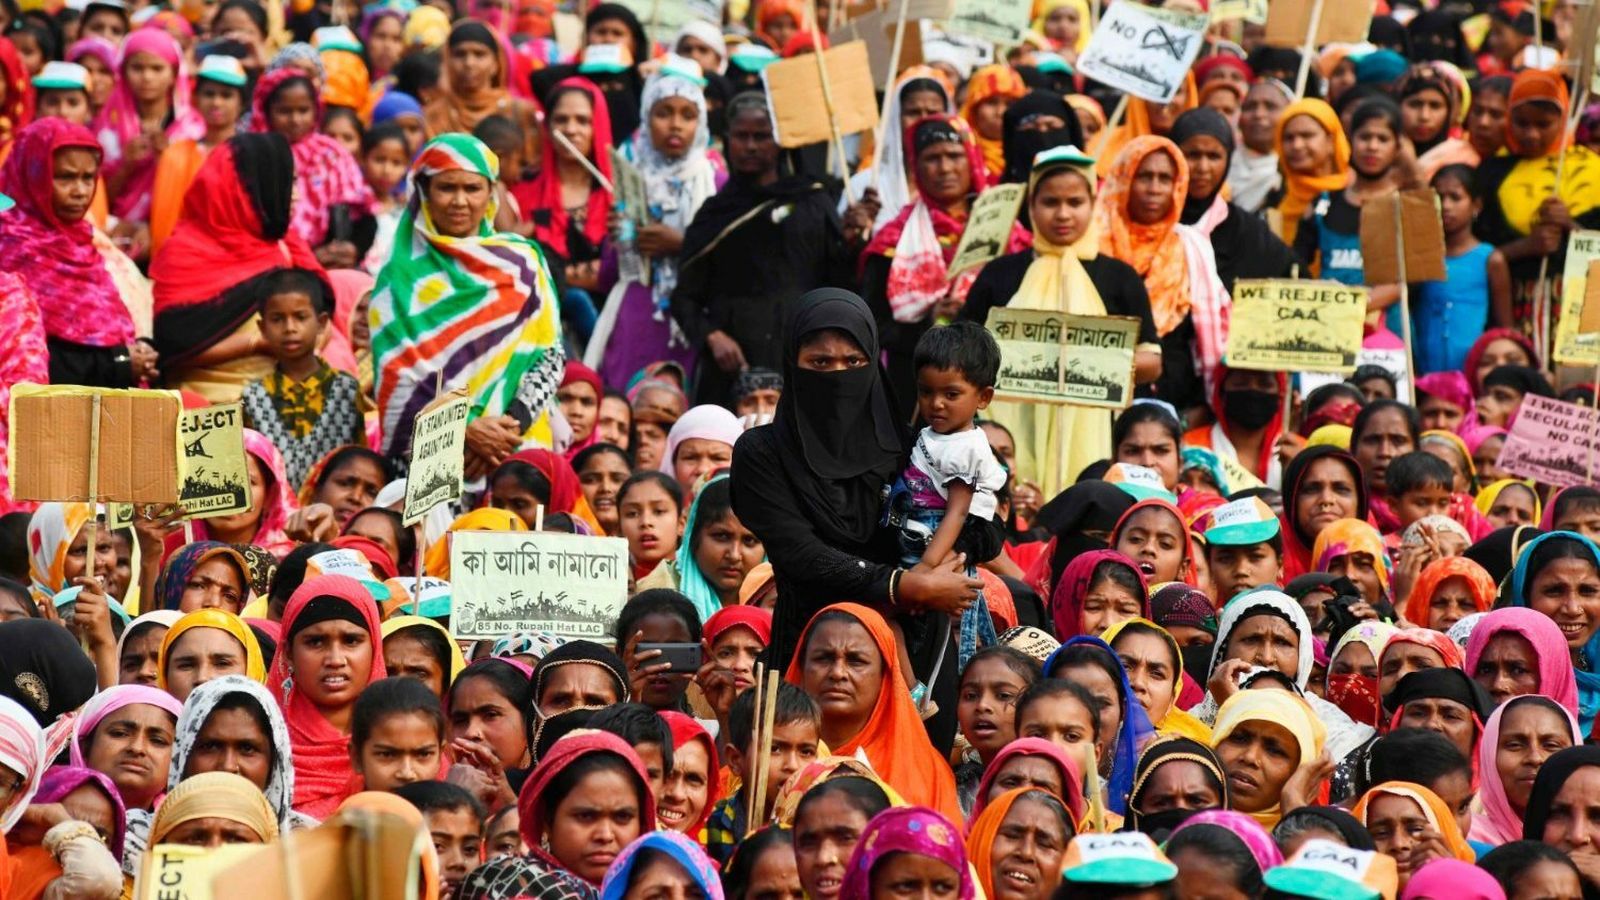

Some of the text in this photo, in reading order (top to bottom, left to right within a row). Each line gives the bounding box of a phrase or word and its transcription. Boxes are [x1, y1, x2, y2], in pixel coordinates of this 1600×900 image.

[1110, 19, 1137, 40] NO
[1574, 238, 1593, 252] WE
[1330, 248, 1364, 269] ZAR
[1240, 287, 1361, 304] WE REJECT
[1277, 307, 1319, 321] CAA
[995, 317, 1127, 349] কা আমি নামানো
[1530, 398, 1537, 407] I
[1541, 400, 1573, 416] WAS
[181, 409, 236, 433] EJECT
[1523, 410, 1590, 433] SECULAR
[1548, 430, 1569, 442] NO
[199, 498, 214, 508] Hat
[216, 495, 233, 506] LAC
[461, 541, 619, 579] কা আমি নামানো
[477, 621, 601, 633] 85 No. Rupahi Hat LAC
[1303, 849, 1359, 870] CAA
[158, 853, 184, 900] ECT
